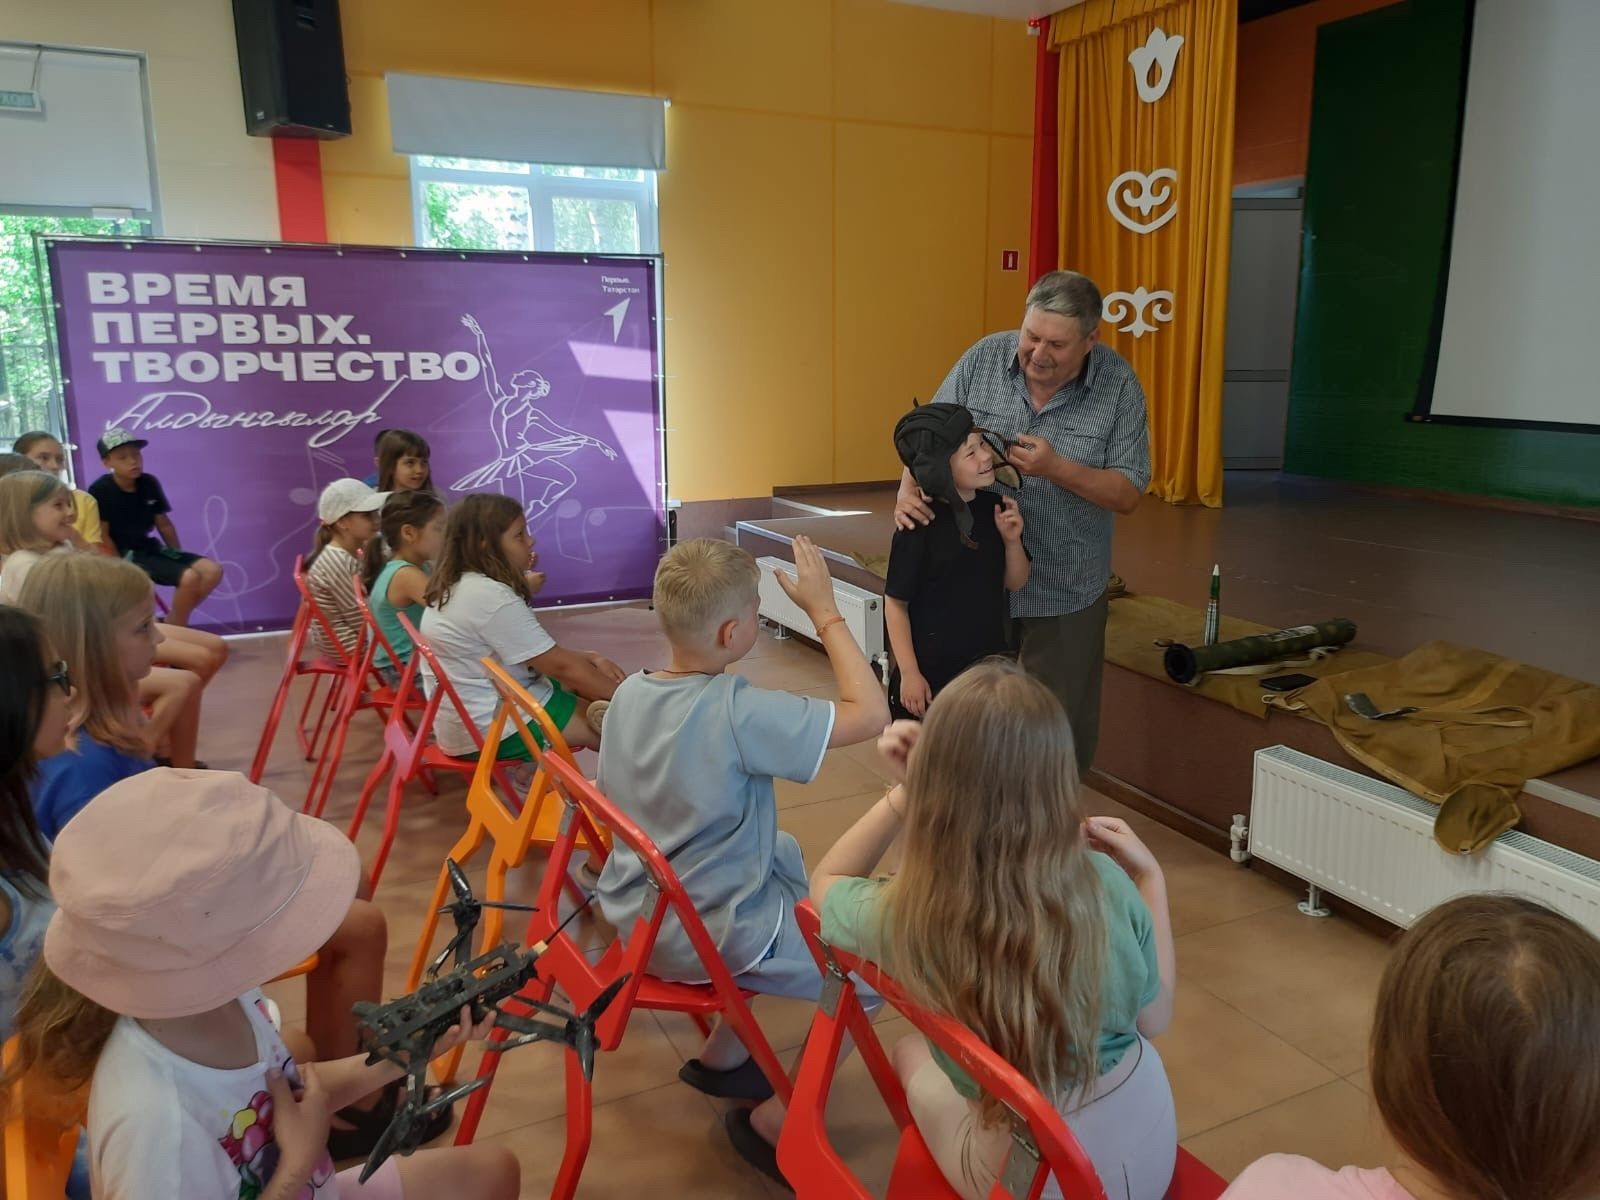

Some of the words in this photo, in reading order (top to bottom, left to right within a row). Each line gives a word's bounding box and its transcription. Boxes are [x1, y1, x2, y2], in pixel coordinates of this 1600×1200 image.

[87, 272, 307, 307] ВРЕМЯ
[92, 312, 371, 344] ПЕРВЫХ.
[93, 351, 481, 383] ТВОРЧЕСТВО
